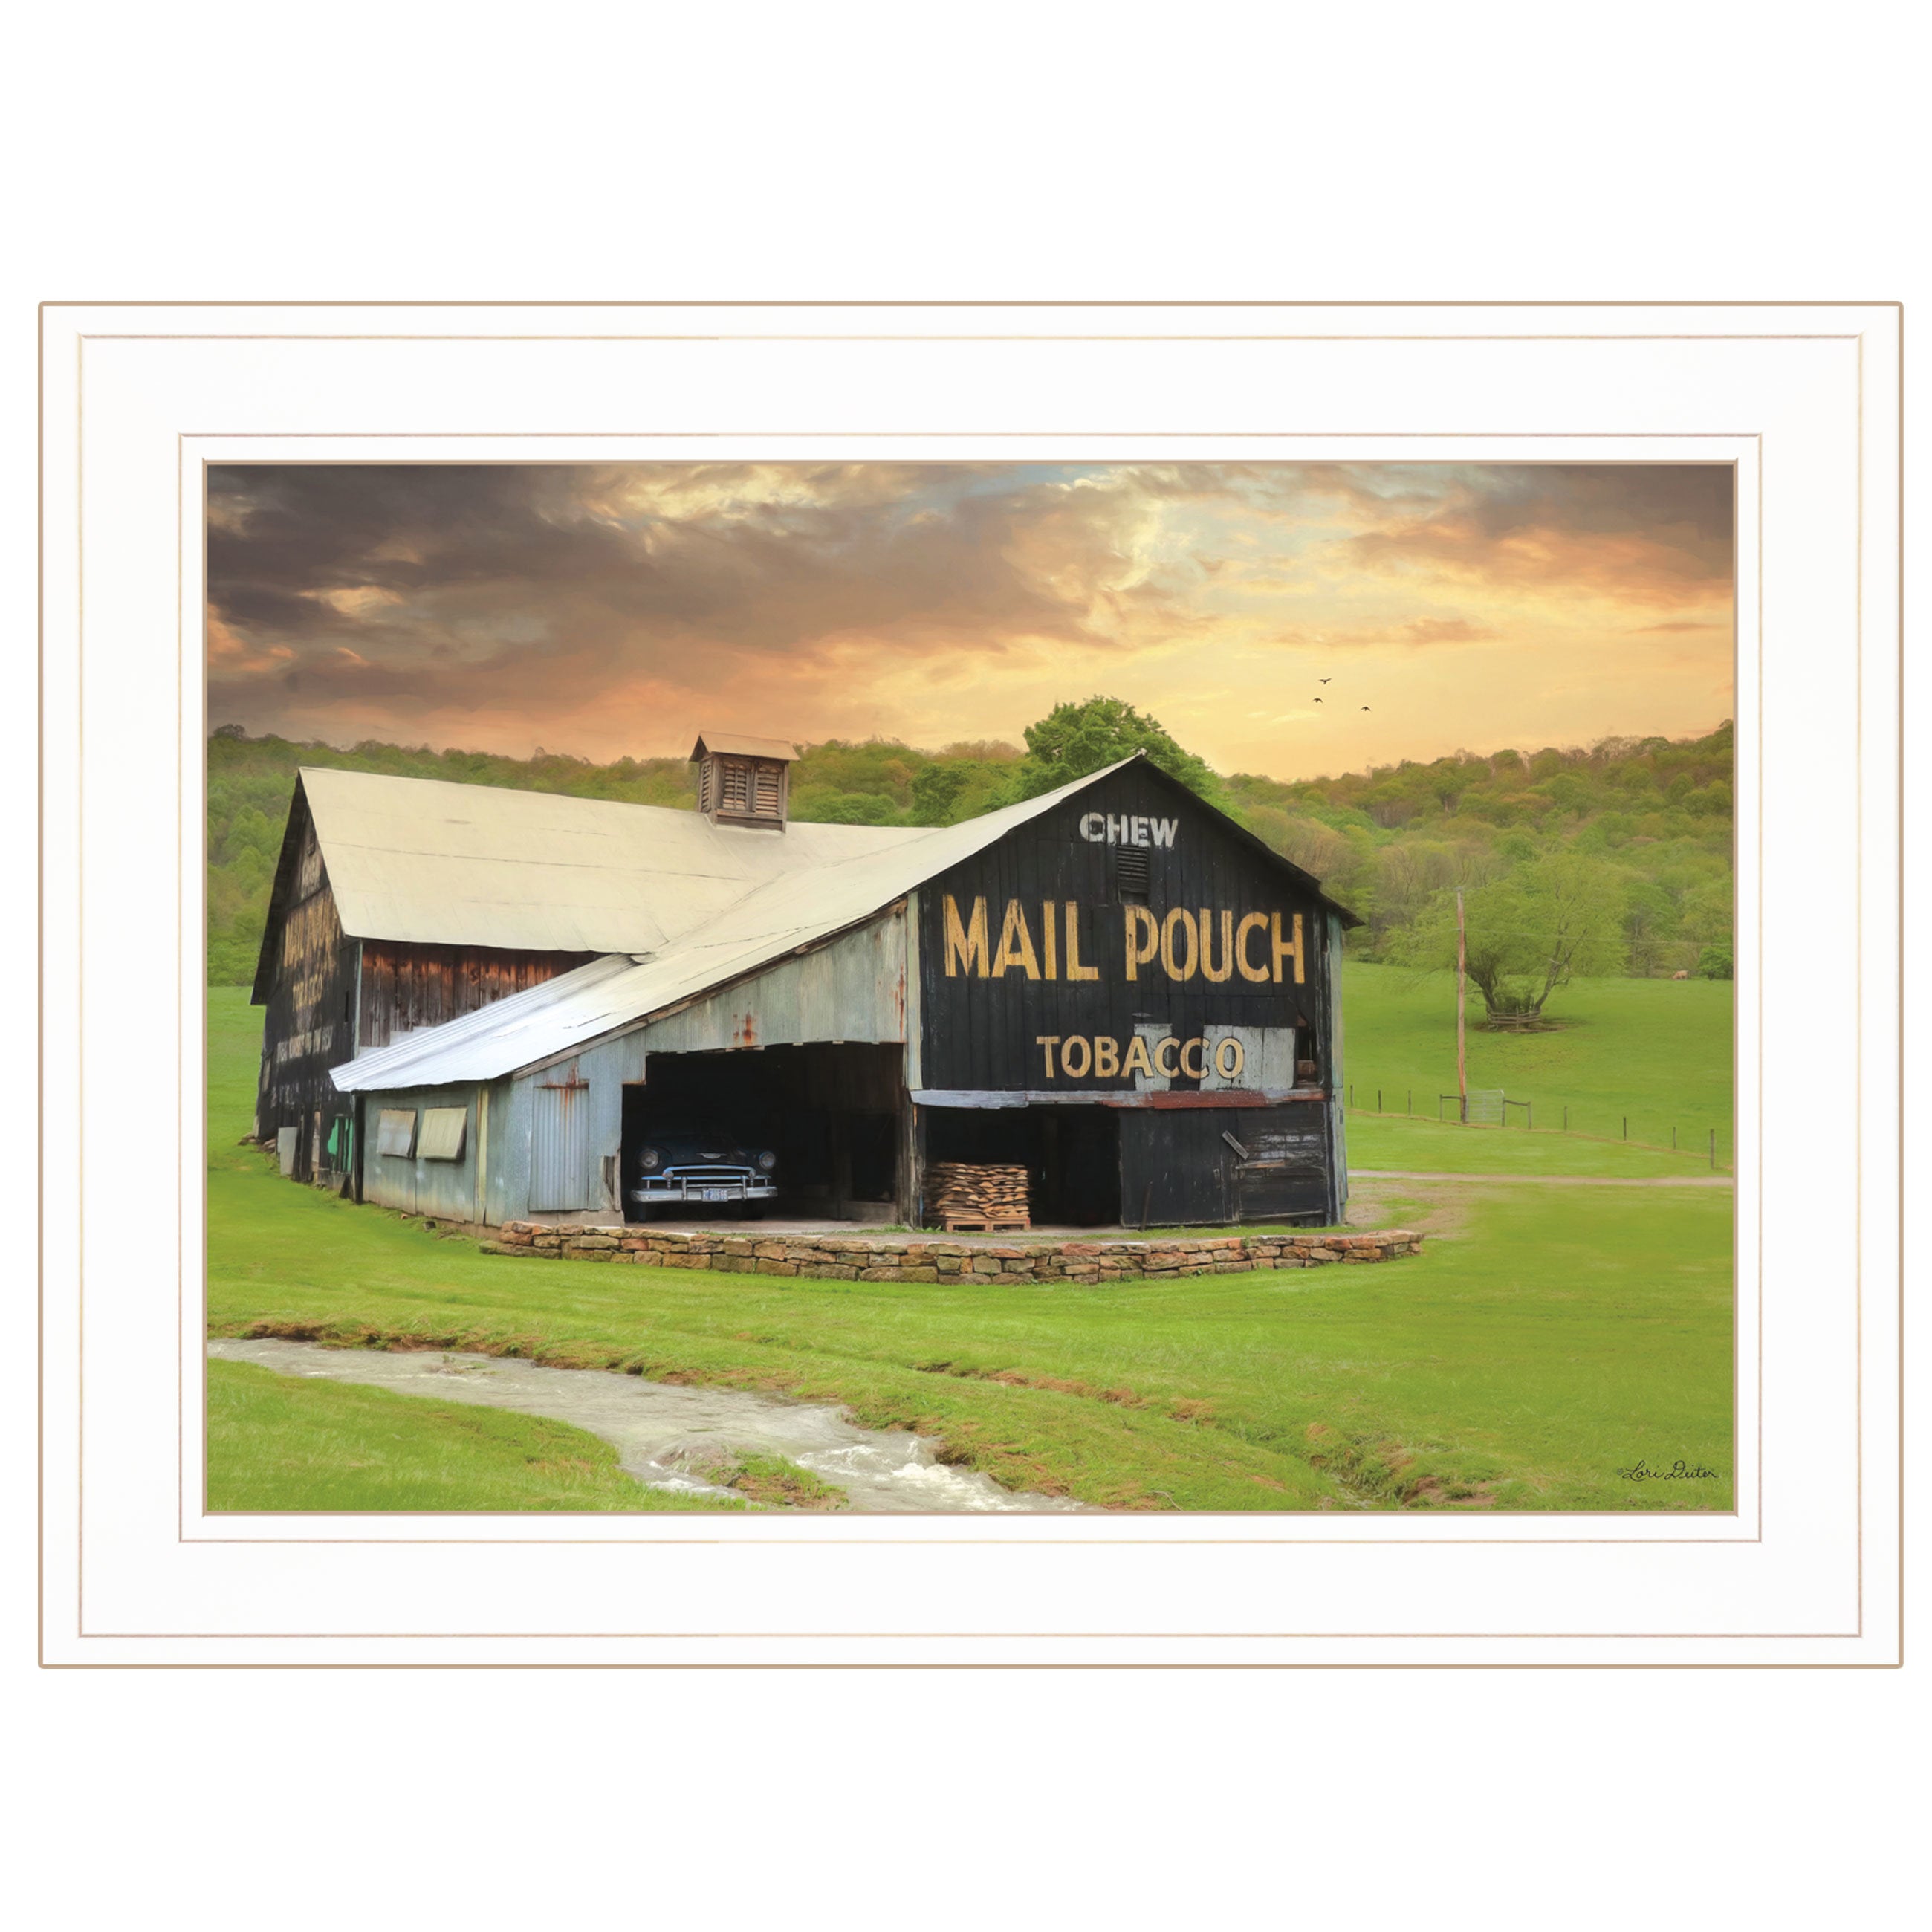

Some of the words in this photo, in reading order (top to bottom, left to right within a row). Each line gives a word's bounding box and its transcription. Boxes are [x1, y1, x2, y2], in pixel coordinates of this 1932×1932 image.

[1080, 812, 1179, 849] CHEW
[943, 894, 1099, 981] MAIL
[1125, 904, 1306, 983] POUCH
[1037, 1035, 1245, 1079] TOBACCO
